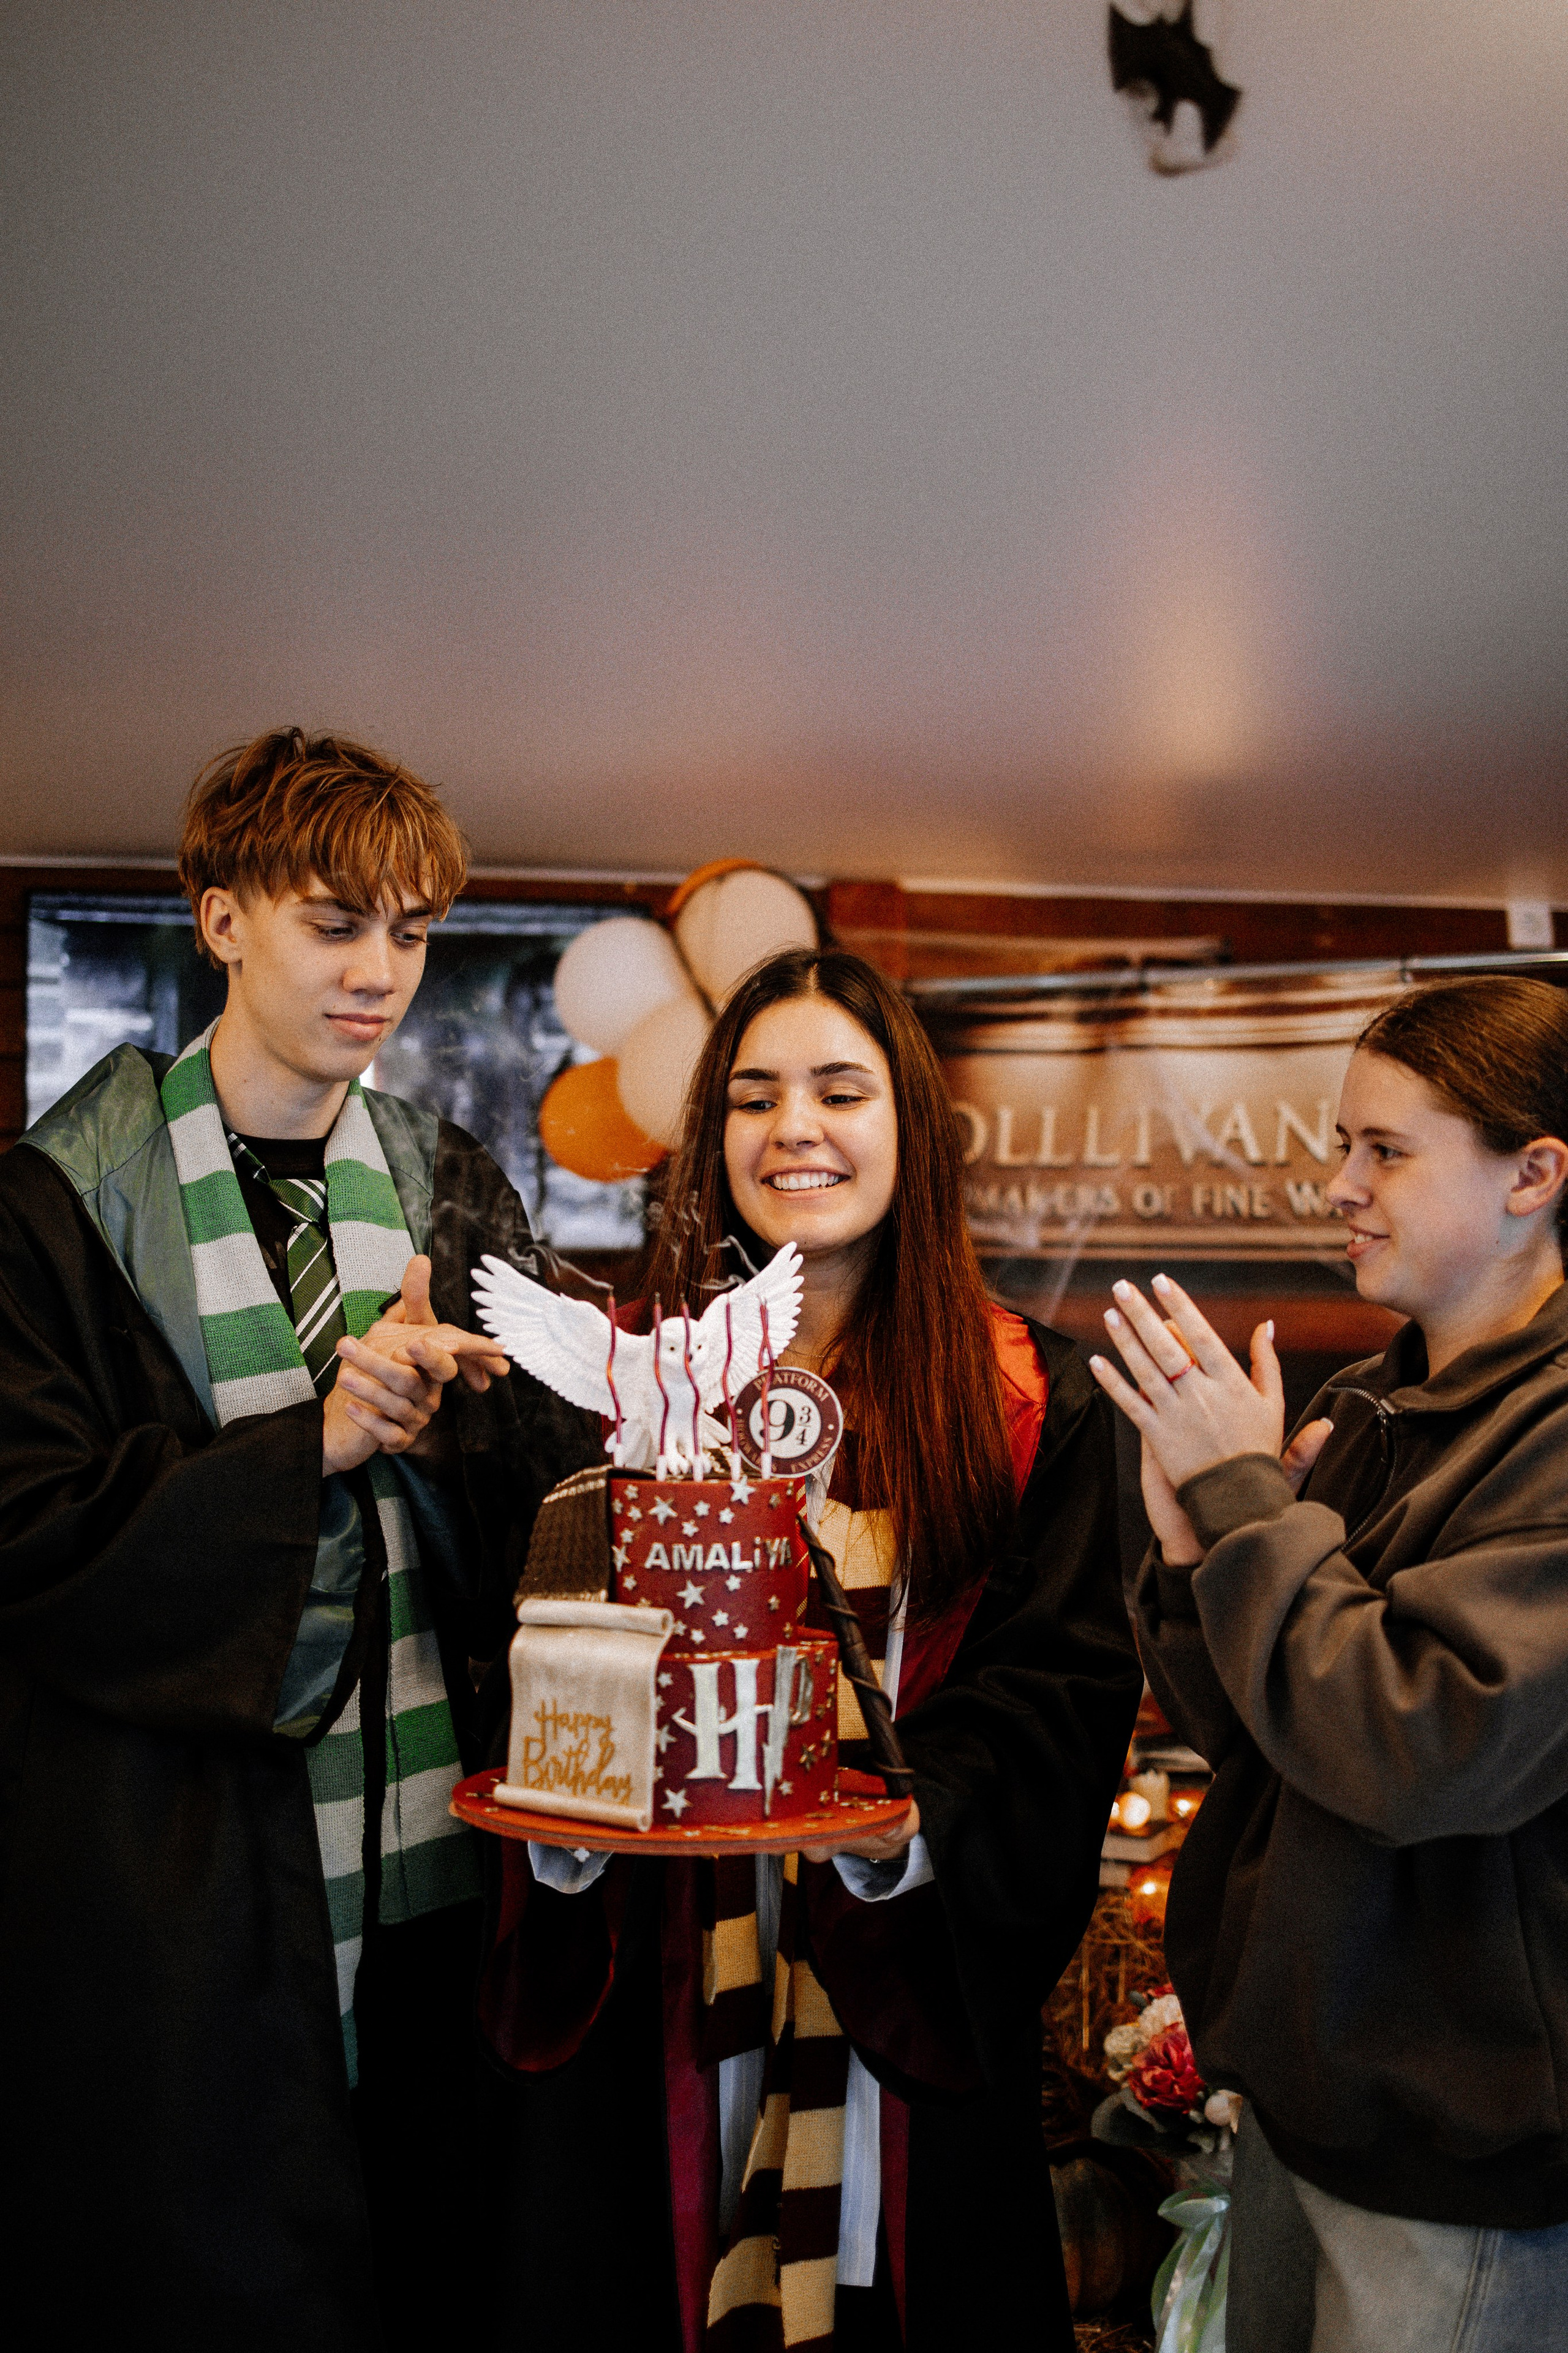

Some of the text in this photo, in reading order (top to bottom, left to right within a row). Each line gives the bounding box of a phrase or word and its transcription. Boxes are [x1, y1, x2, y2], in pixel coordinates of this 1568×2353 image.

[1193, 1181, 1273, 1218] FINE
[754, 1372, 829, 1402] PATFORM
[533, 1698, 614, 1741] Happy
